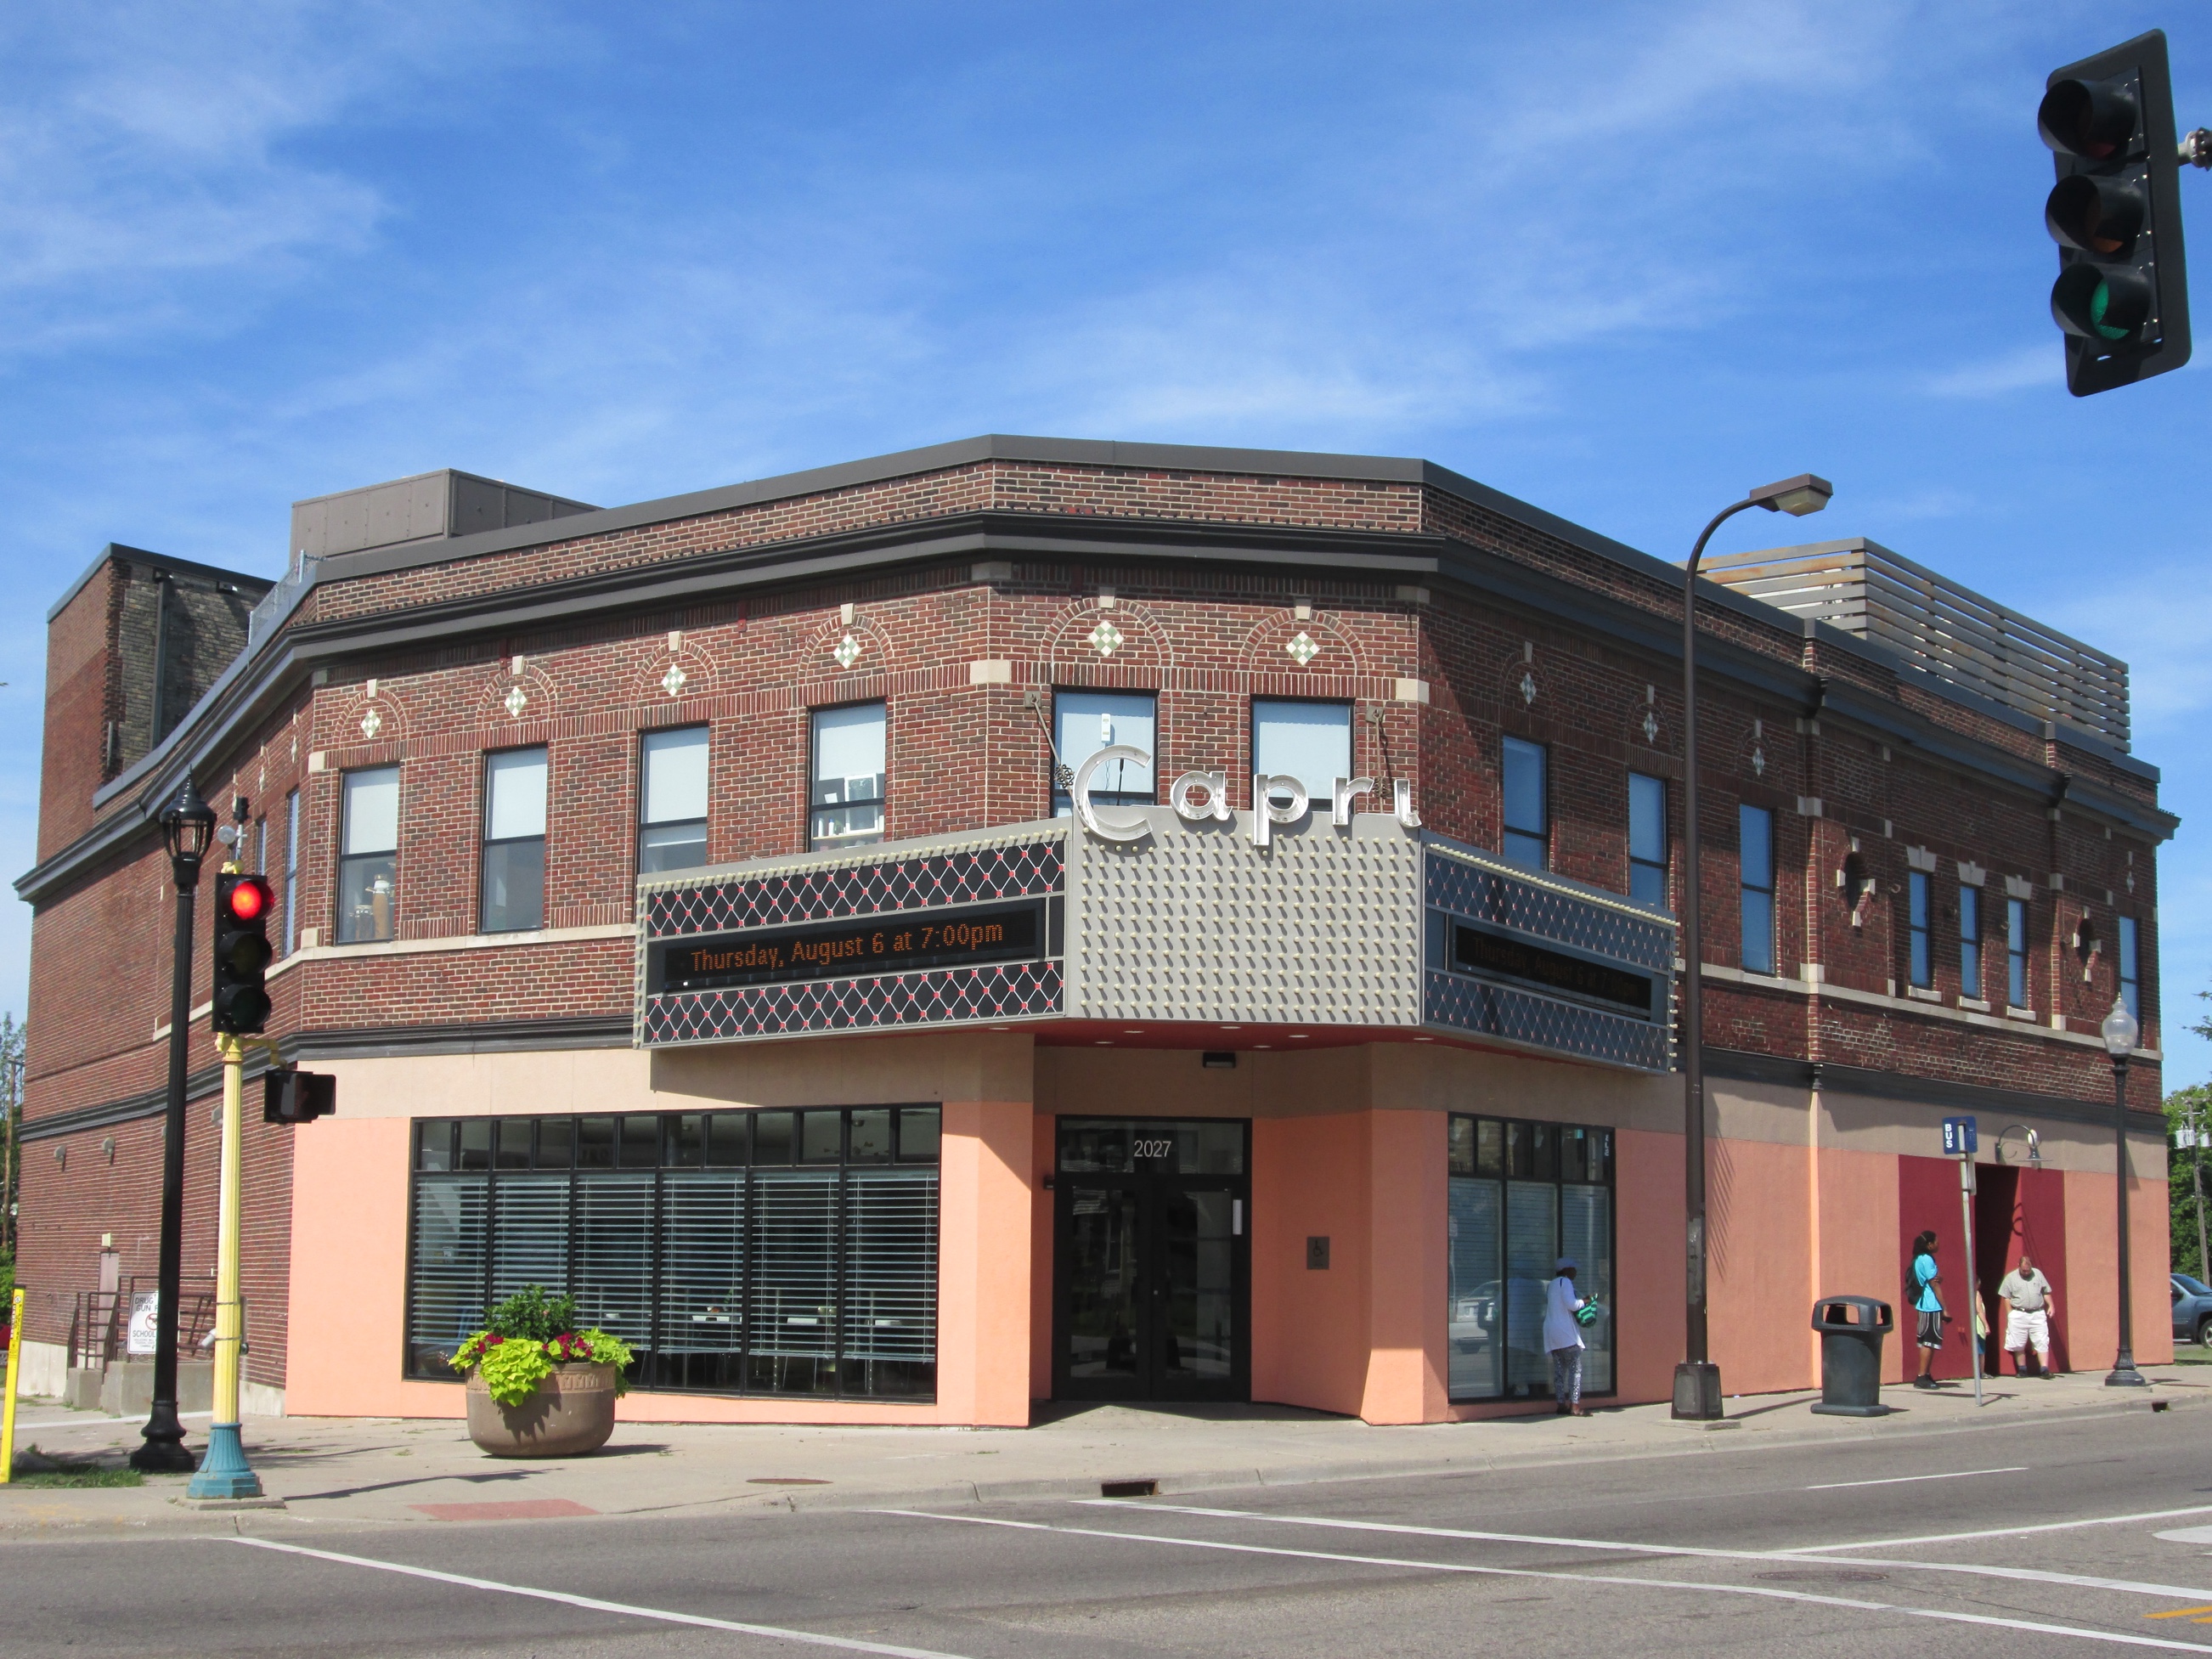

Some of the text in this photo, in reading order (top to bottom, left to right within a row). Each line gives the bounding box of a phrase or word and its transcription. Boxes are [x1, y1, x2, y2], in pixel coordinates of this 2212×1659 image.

[1072, 744, 1422, 846] Capri
[690, 923, 1004, 970] Thursday, August 6 at 7:00pm
[1535, 954, 1573, 985] August
[1133, 1140, 1171, 1158] 2027
[133, 1329, 156, 1338] SCHOOL
